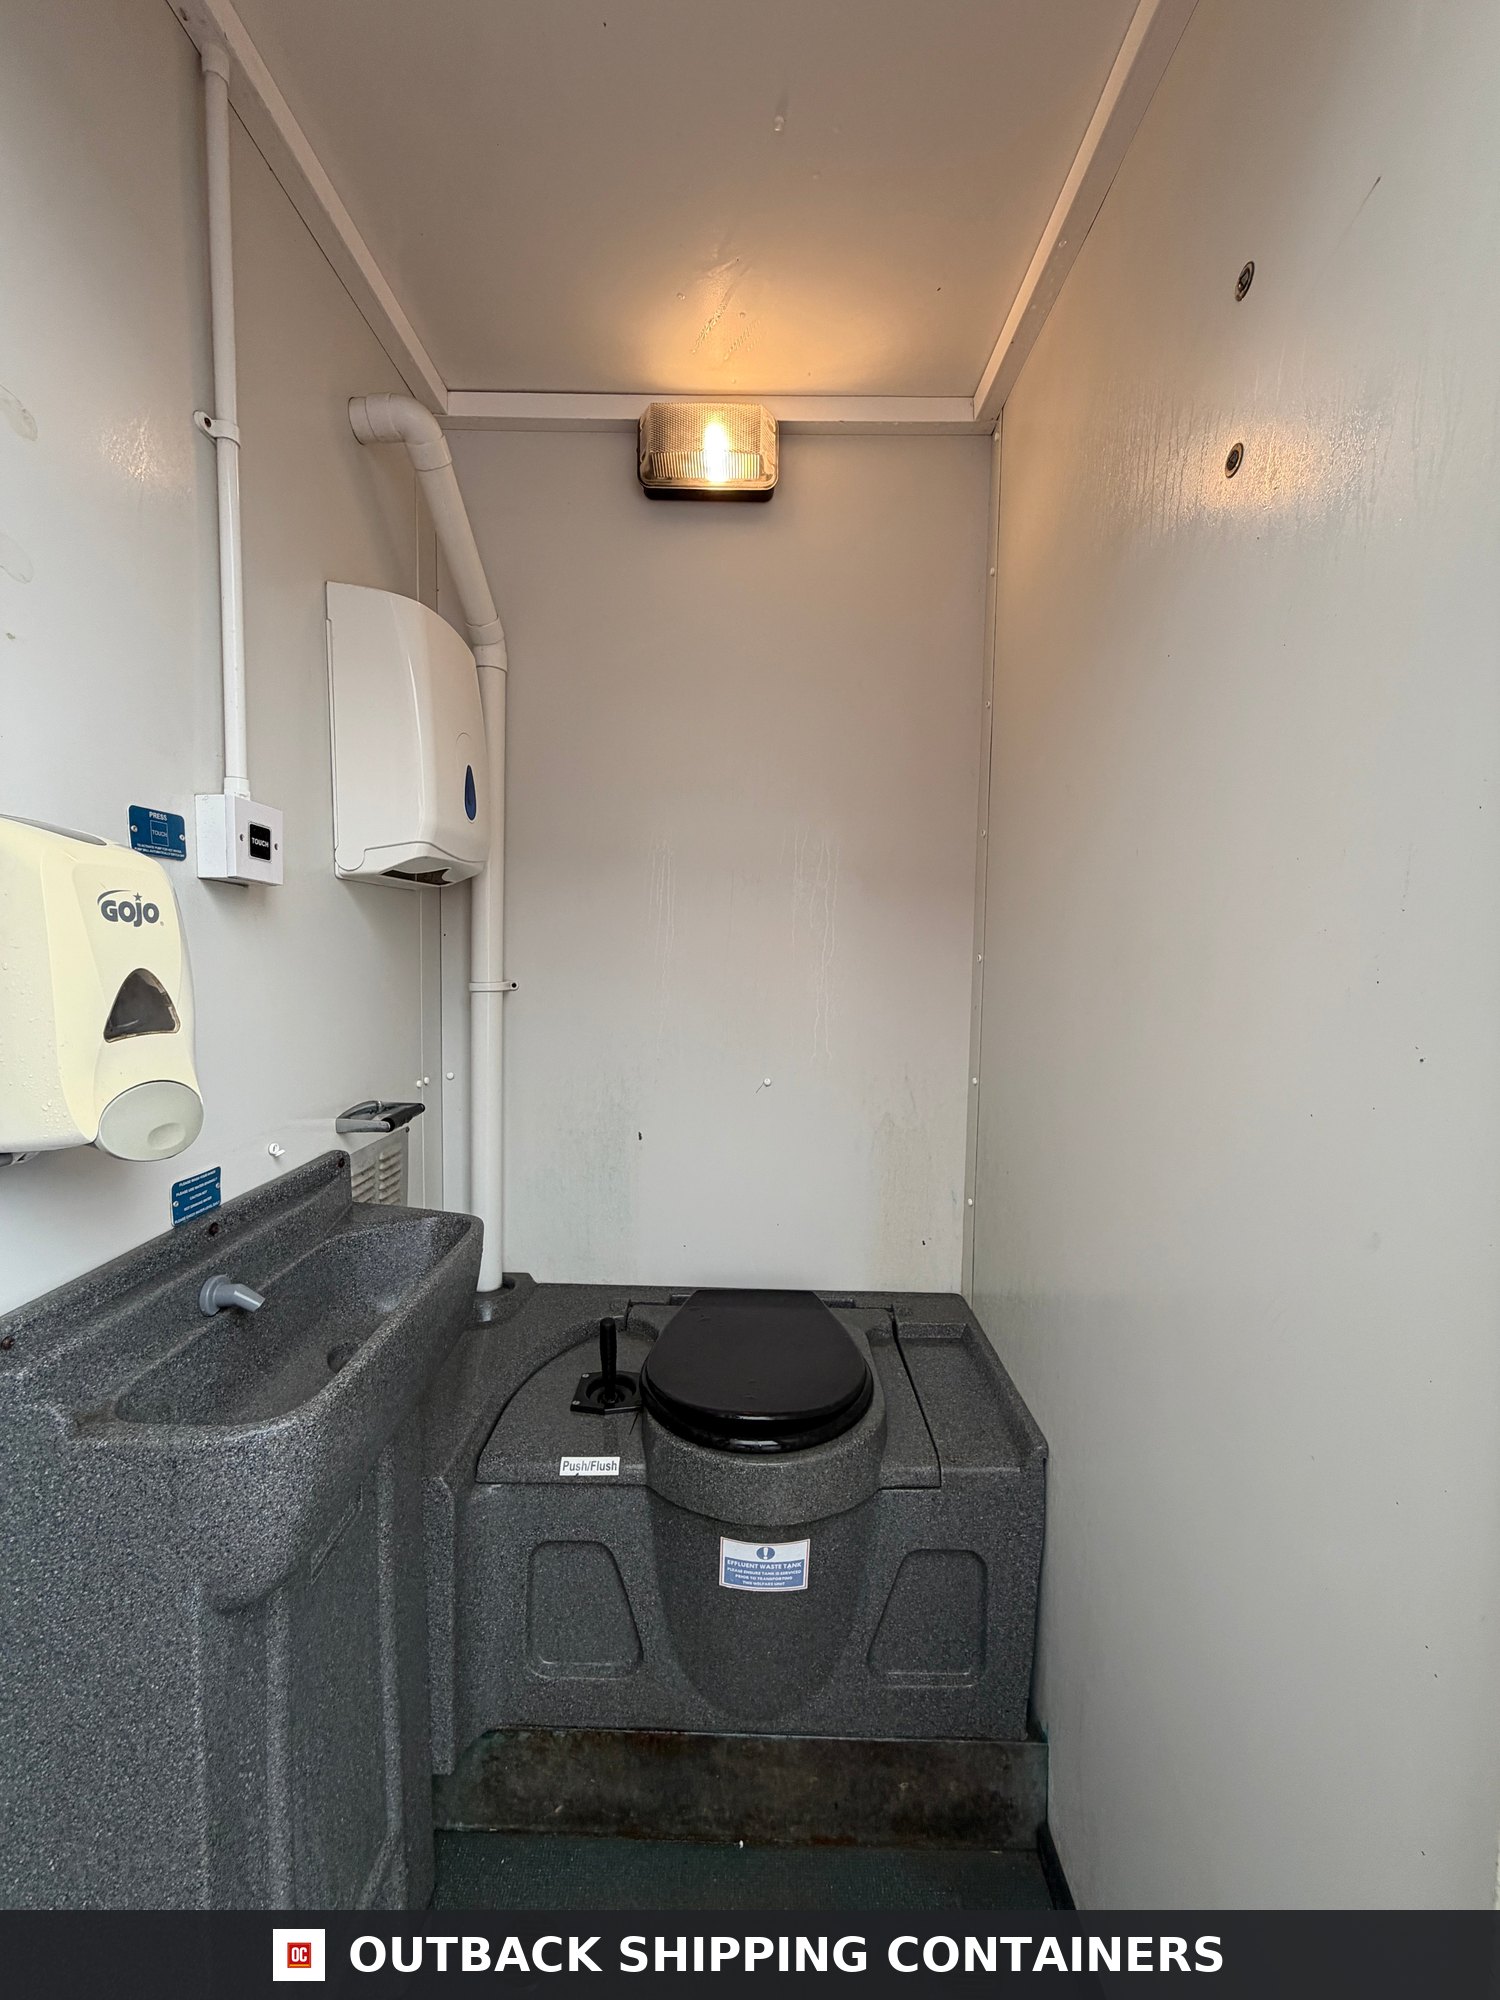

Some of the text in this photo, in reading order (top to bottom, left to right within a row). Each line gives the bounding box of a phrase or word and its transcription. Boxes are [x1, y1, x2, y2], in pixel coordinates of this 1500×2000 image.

[148, 811, 168, 822] PRESS
[251, 836, 270, 849] TOUCH
[562, 1460, 618, 1471] Push/Flush
[727, 1560, 759, 1569] EFFLUENT
[783, 1561, 802, 1569] TANK
